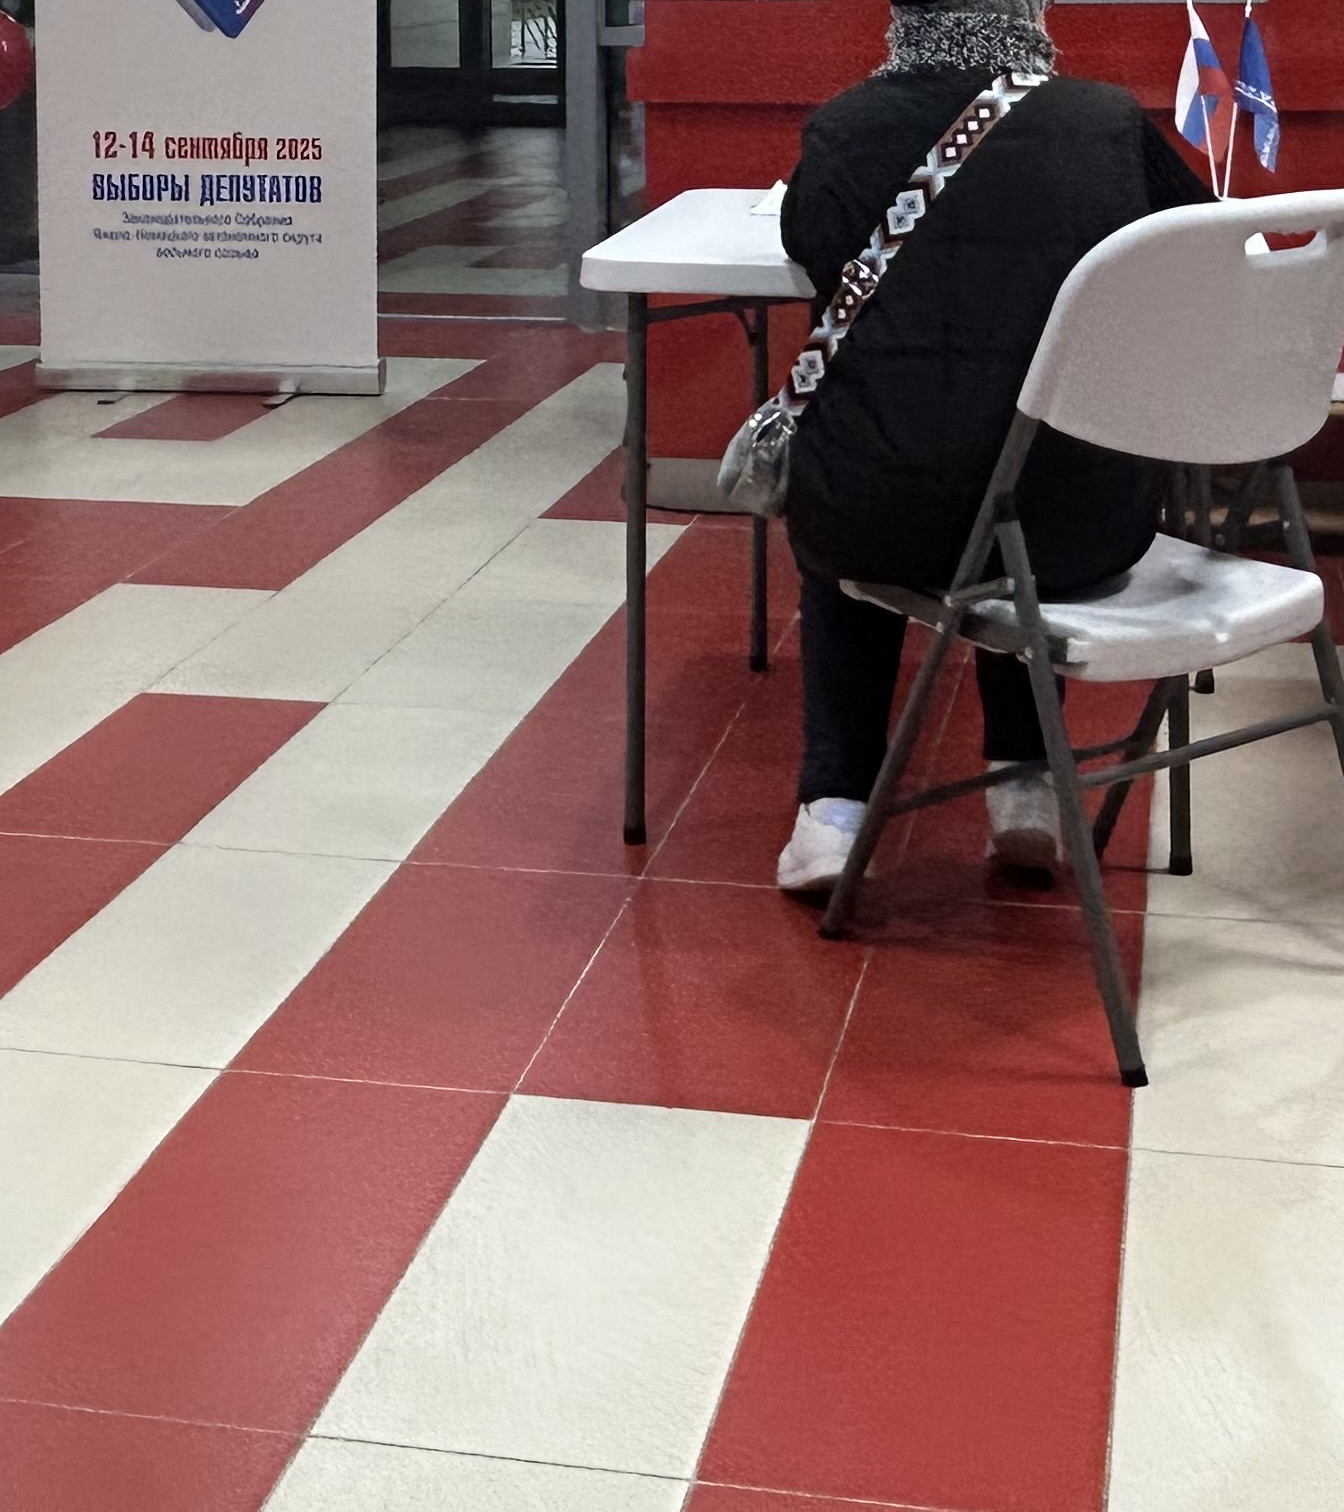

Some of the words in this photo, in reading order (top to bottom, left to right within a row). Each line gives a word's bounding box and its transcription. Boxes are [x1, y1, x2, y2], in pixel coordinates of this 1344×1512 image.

[92, 131, 155, 160] 12-14
[164, 131, 268, 167] сентября
[276, 138, 323, 160] 2025
[92, 173, 190, 202] ВЫБОРЫ
[199, 174, 323, 206] ДЕПУТАТОВ
